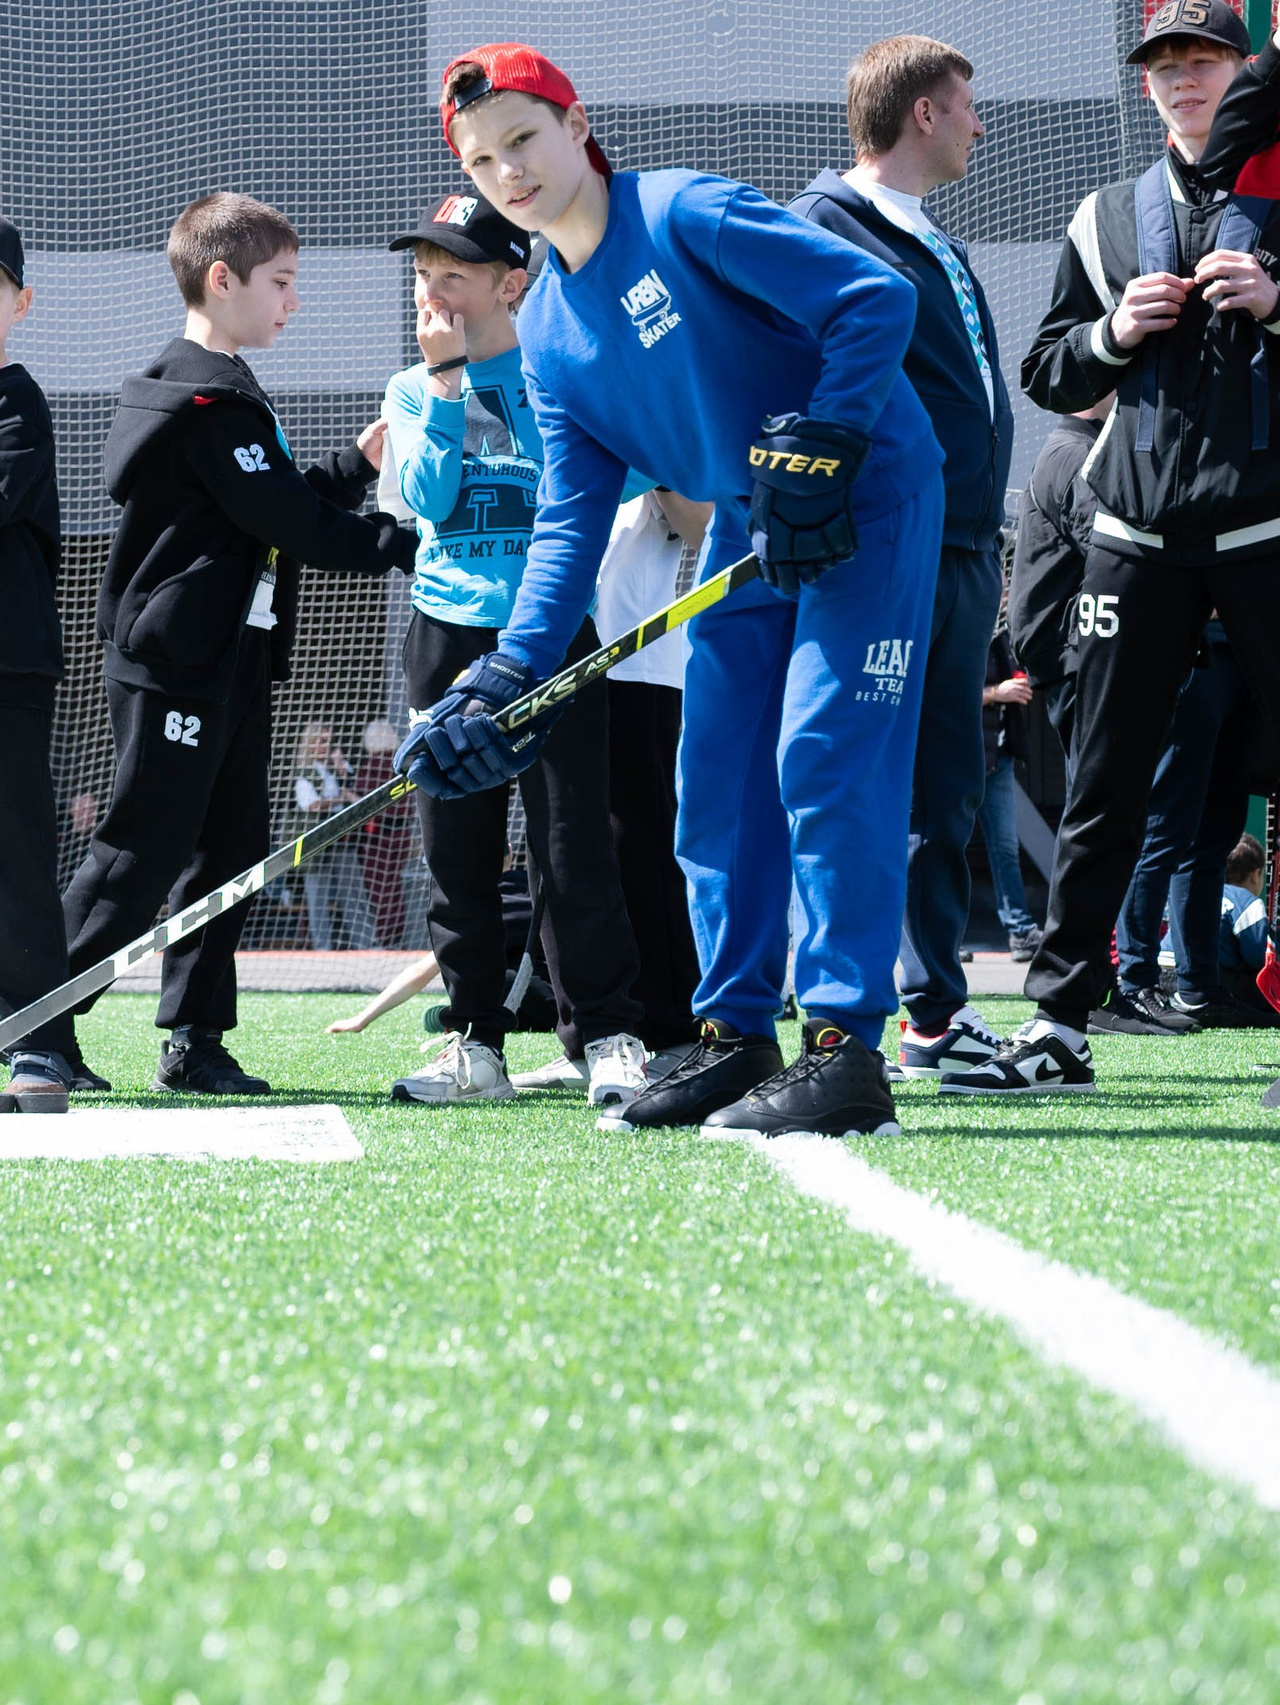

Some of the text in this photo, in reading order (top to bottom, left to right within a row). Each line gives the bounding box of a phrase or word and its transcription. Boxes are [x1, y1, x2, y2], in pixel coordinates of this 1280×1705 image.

[1155, 0, 1211, 31] 95
[1254, 248, 1278, 266] SITY
[621, 269, 669, 315] URBN
[639, 313, 682, 349] SKATER
[233, 443, 270, 472] 62
[462, 462, 537, 482] ENTUROUS
[749, 445, 841, 477] OTER
[469, 541, 497, 558] MY
[1078, 593, 1120, 638] 95
[489, 661, 525, 680] SHOOTER
[875, 678, 904, 694] TEA
[502, 672, 578, 731] CKS
[855, 691, 888, 702] BEST
[164, 710, 201, 747] 62
[114, 861, 265, 980] CCM
